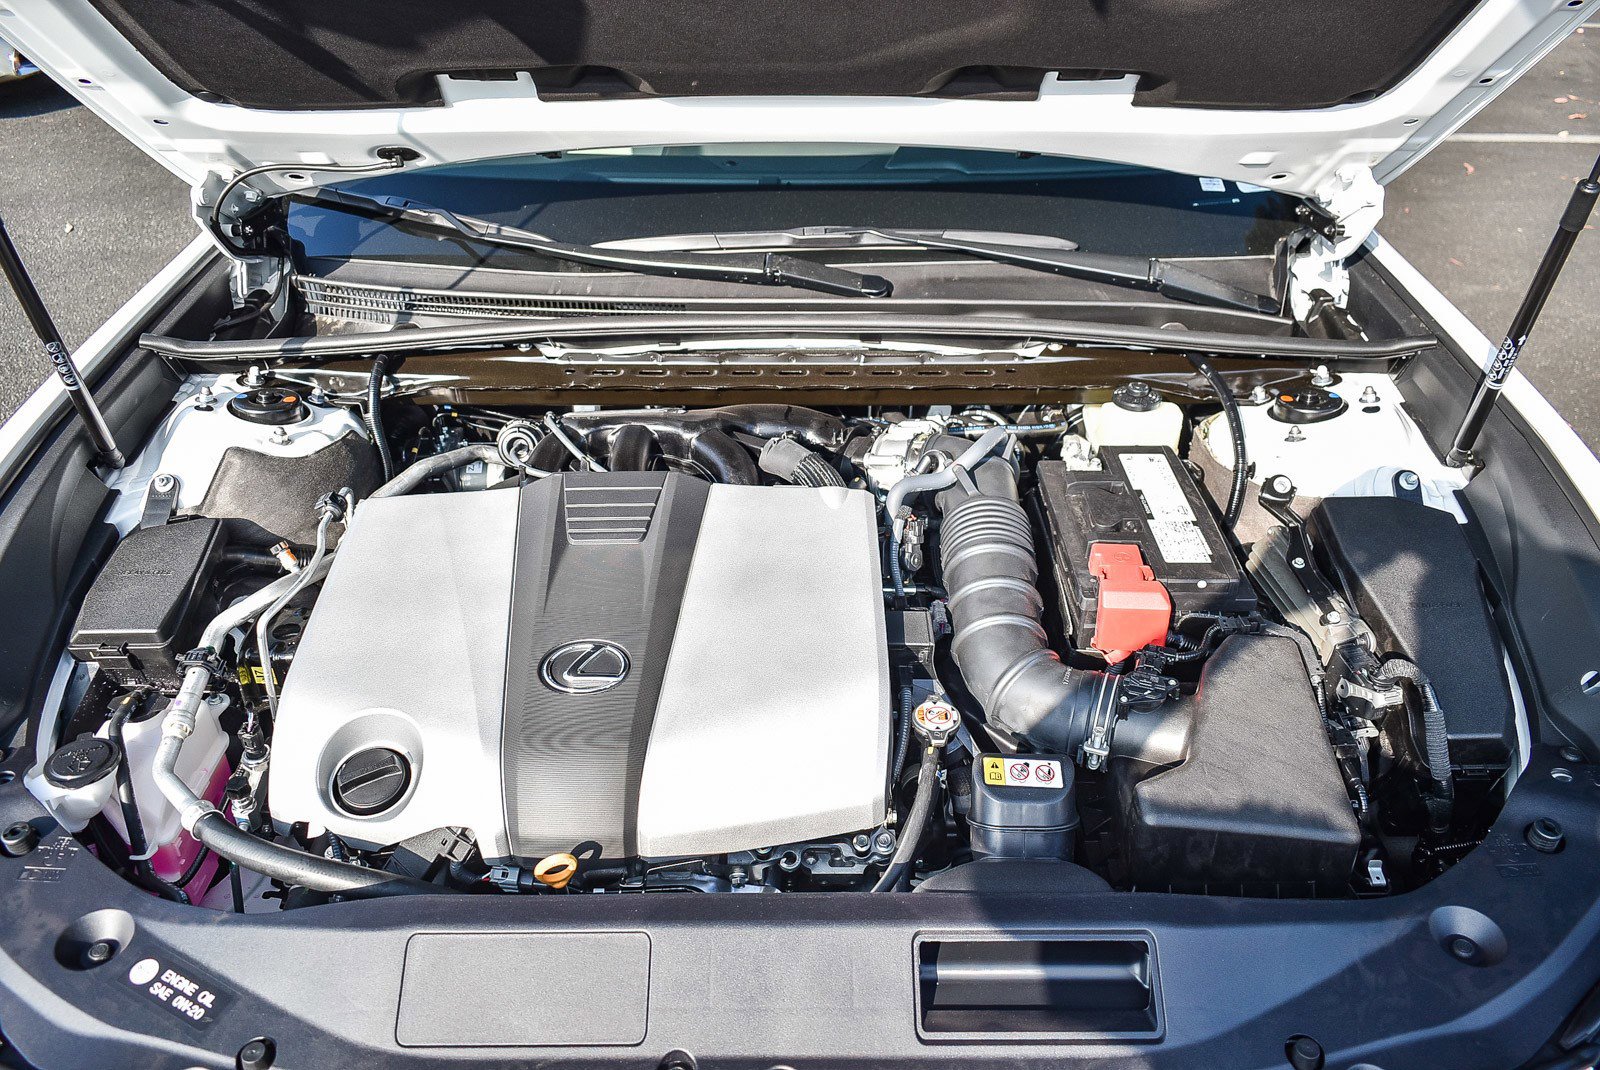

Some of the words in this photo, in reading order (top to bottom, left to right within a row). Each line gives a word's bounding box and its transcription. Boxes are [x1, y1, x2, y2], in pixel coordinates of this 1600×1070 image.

[149, 982, 174, 1001] SAE
[172, 995, 205, 1020] 0W-20
[160, 969, 199, 997] ENGINE
[197, 990, 216, 1009] OIL
